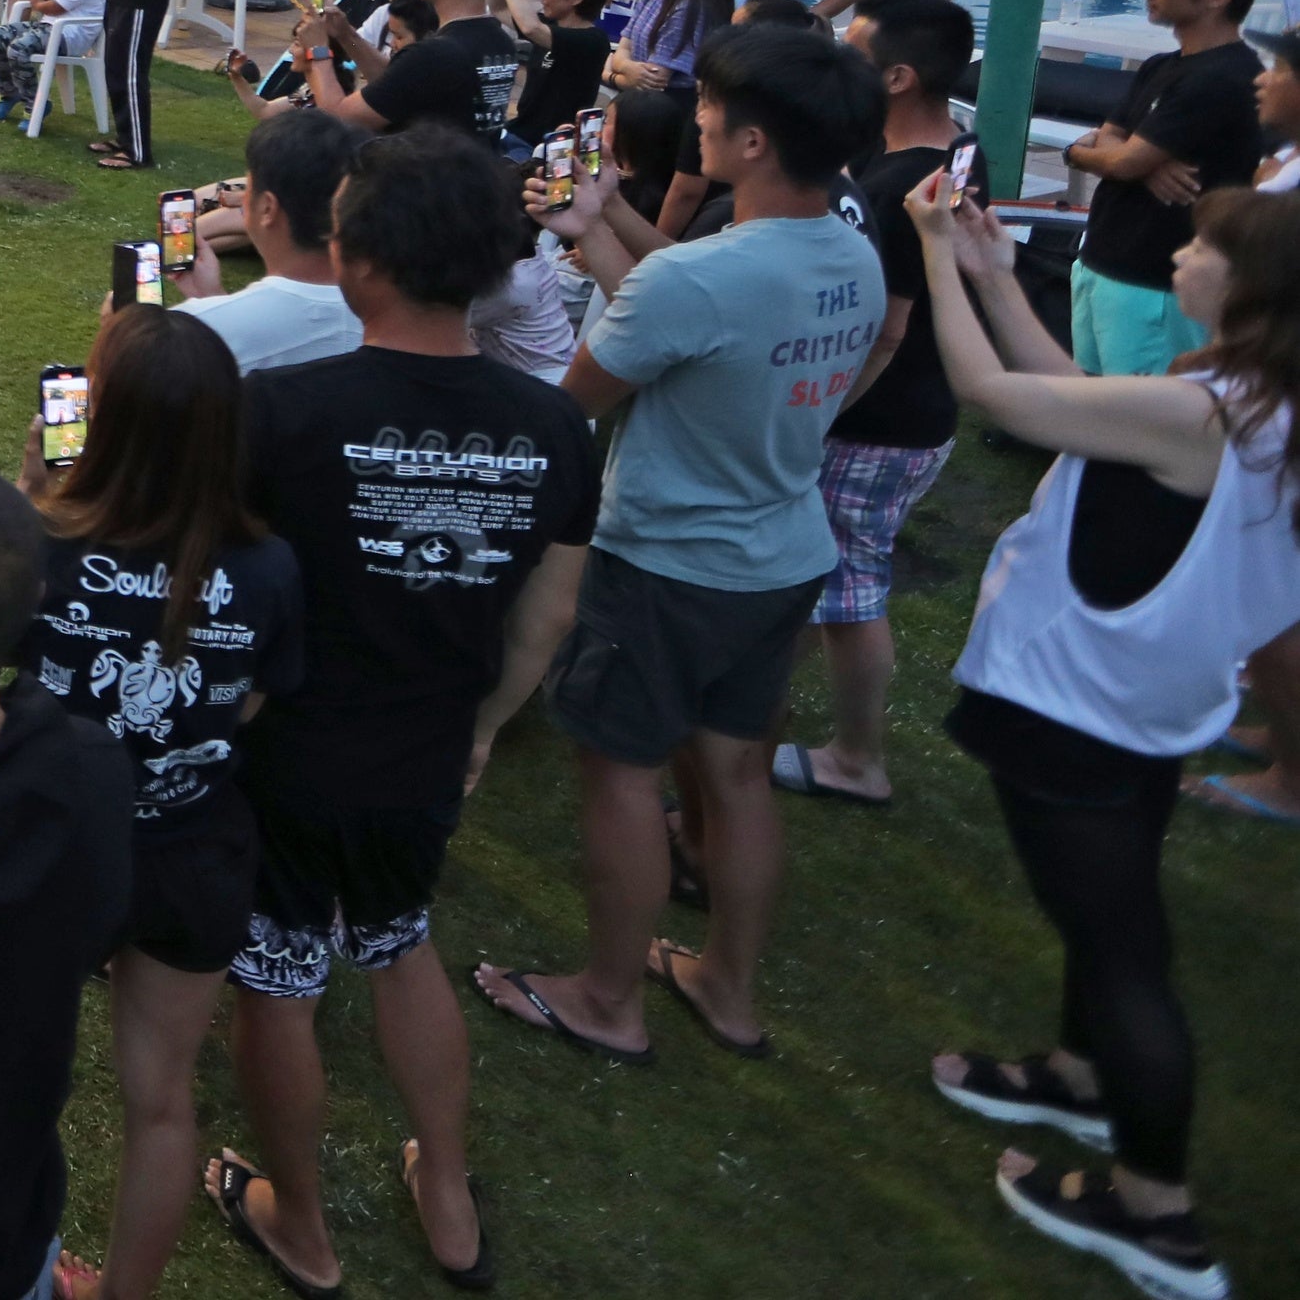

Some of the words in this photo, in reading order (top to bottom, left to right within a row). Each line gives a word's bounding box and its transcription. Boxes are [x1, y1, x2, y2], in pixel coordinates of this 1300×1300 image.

[816, 280, 860, 318] THE
[343, 443, 548, 471] CENTURION
[395, 465, 501, 482] BOATS
